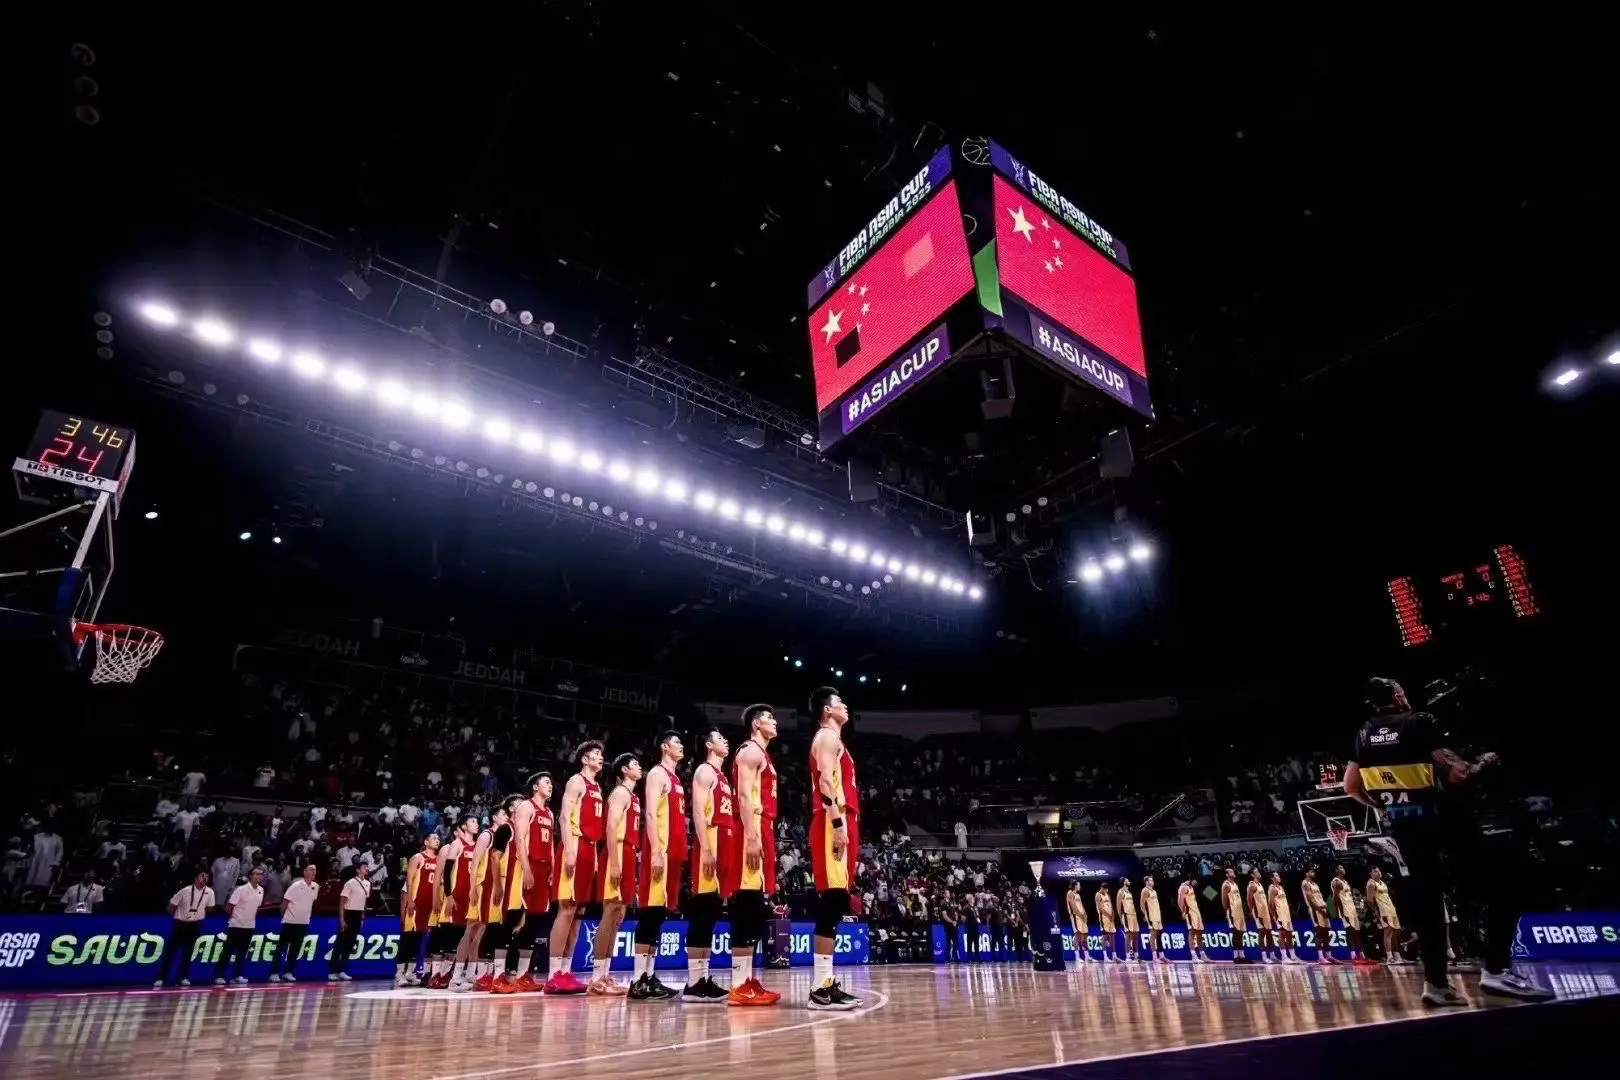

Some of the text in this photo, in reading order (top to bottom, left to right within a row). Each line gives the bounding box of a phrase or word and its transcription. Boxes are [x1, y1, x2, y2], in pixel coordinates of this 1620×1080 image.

[839, 165, 929, 268] FIBA ASIA CUP
[1028, 169, 1113, 245] FIBA ASIA CUP
[840, 181, 931, 276] SAUDI ARABIA 2025
[1038, 326, 1124, 391] #ASIACUP
[848, 337, 940, 421] #ASIACUP
[39, 437, 104, 474] 24
[52, 466, 106, 485] TISSOT
[453, 660, 526, 688] JEDDAH
[1385, 732, 1399, 741] CUP
[1320, 772, 1337, 785] 24
[1, 932, 41, 949] ASIA
[660, 932, 681, 944] ASIA
[1532, 925, 1579, 944] FIBA
[1578, 933, 1598, 943] CUP
[660, 943, 680, 956] CUP
